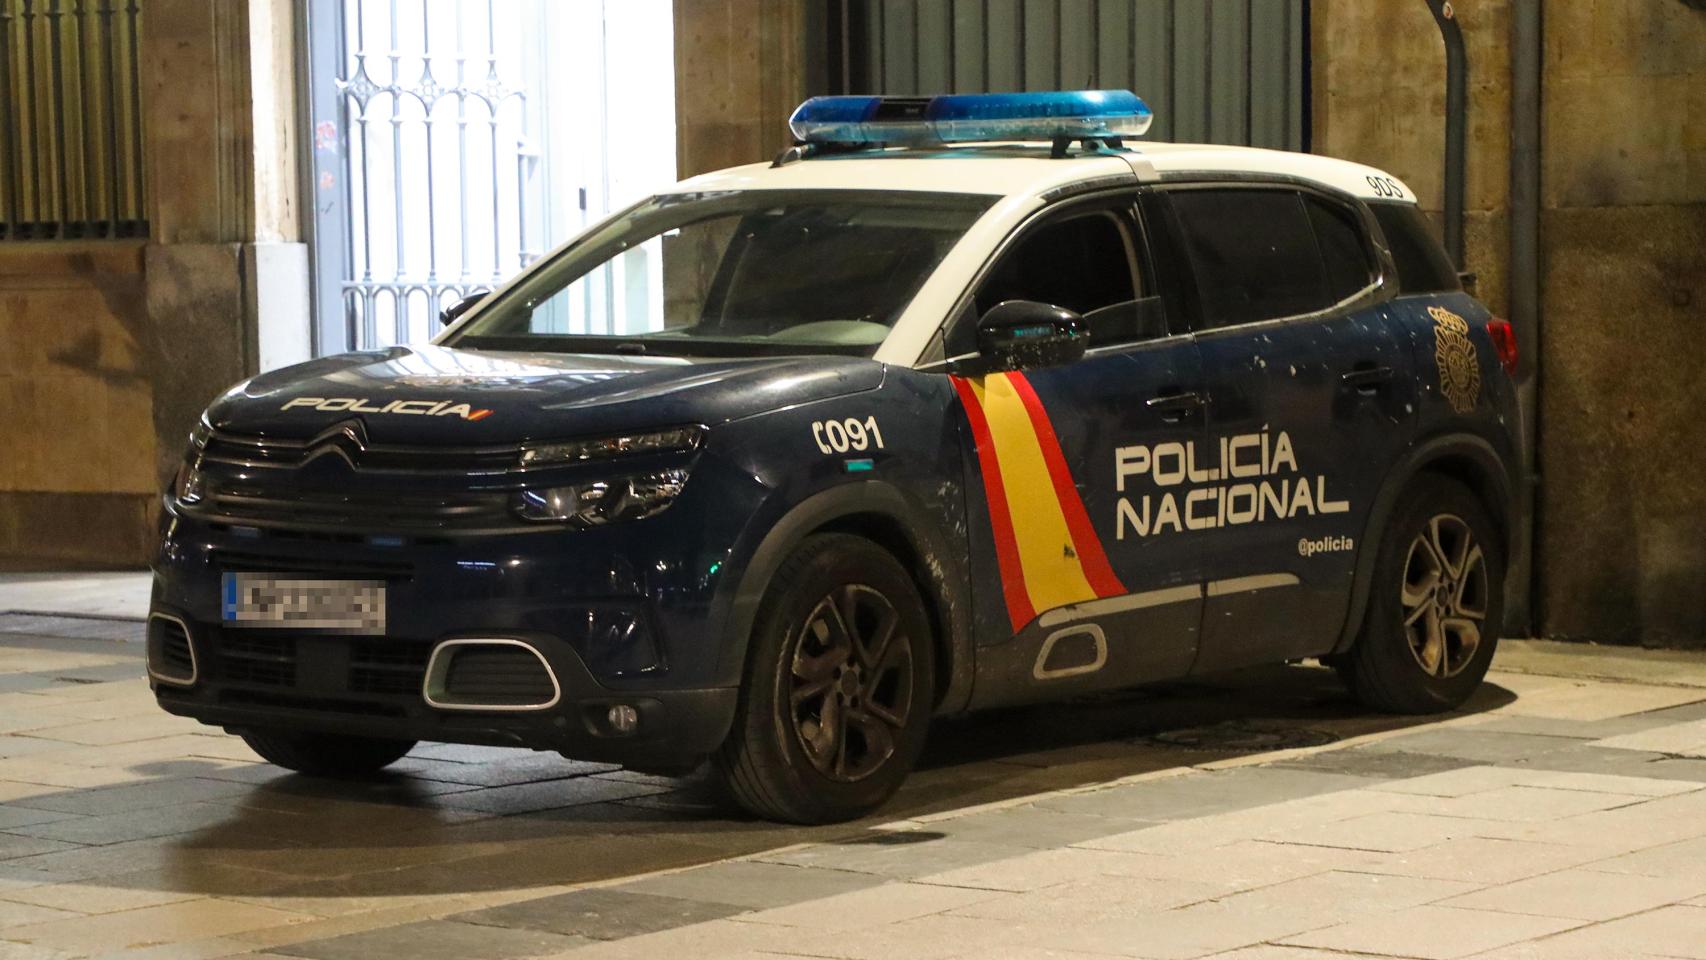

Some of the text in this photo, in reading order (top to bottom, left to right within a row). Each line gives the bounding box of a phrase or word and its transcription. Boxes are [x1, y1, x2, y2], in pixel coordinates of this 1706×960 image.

[1366, 175, 1403, 198] 9DS
[280, 397, 471, 418] POLICÍA
[1115, 423, 1298, 492] POLICÍA
[1116, 475, 1350, 540] NACIONAL
[1298, 535, 1354, 557] @policia
